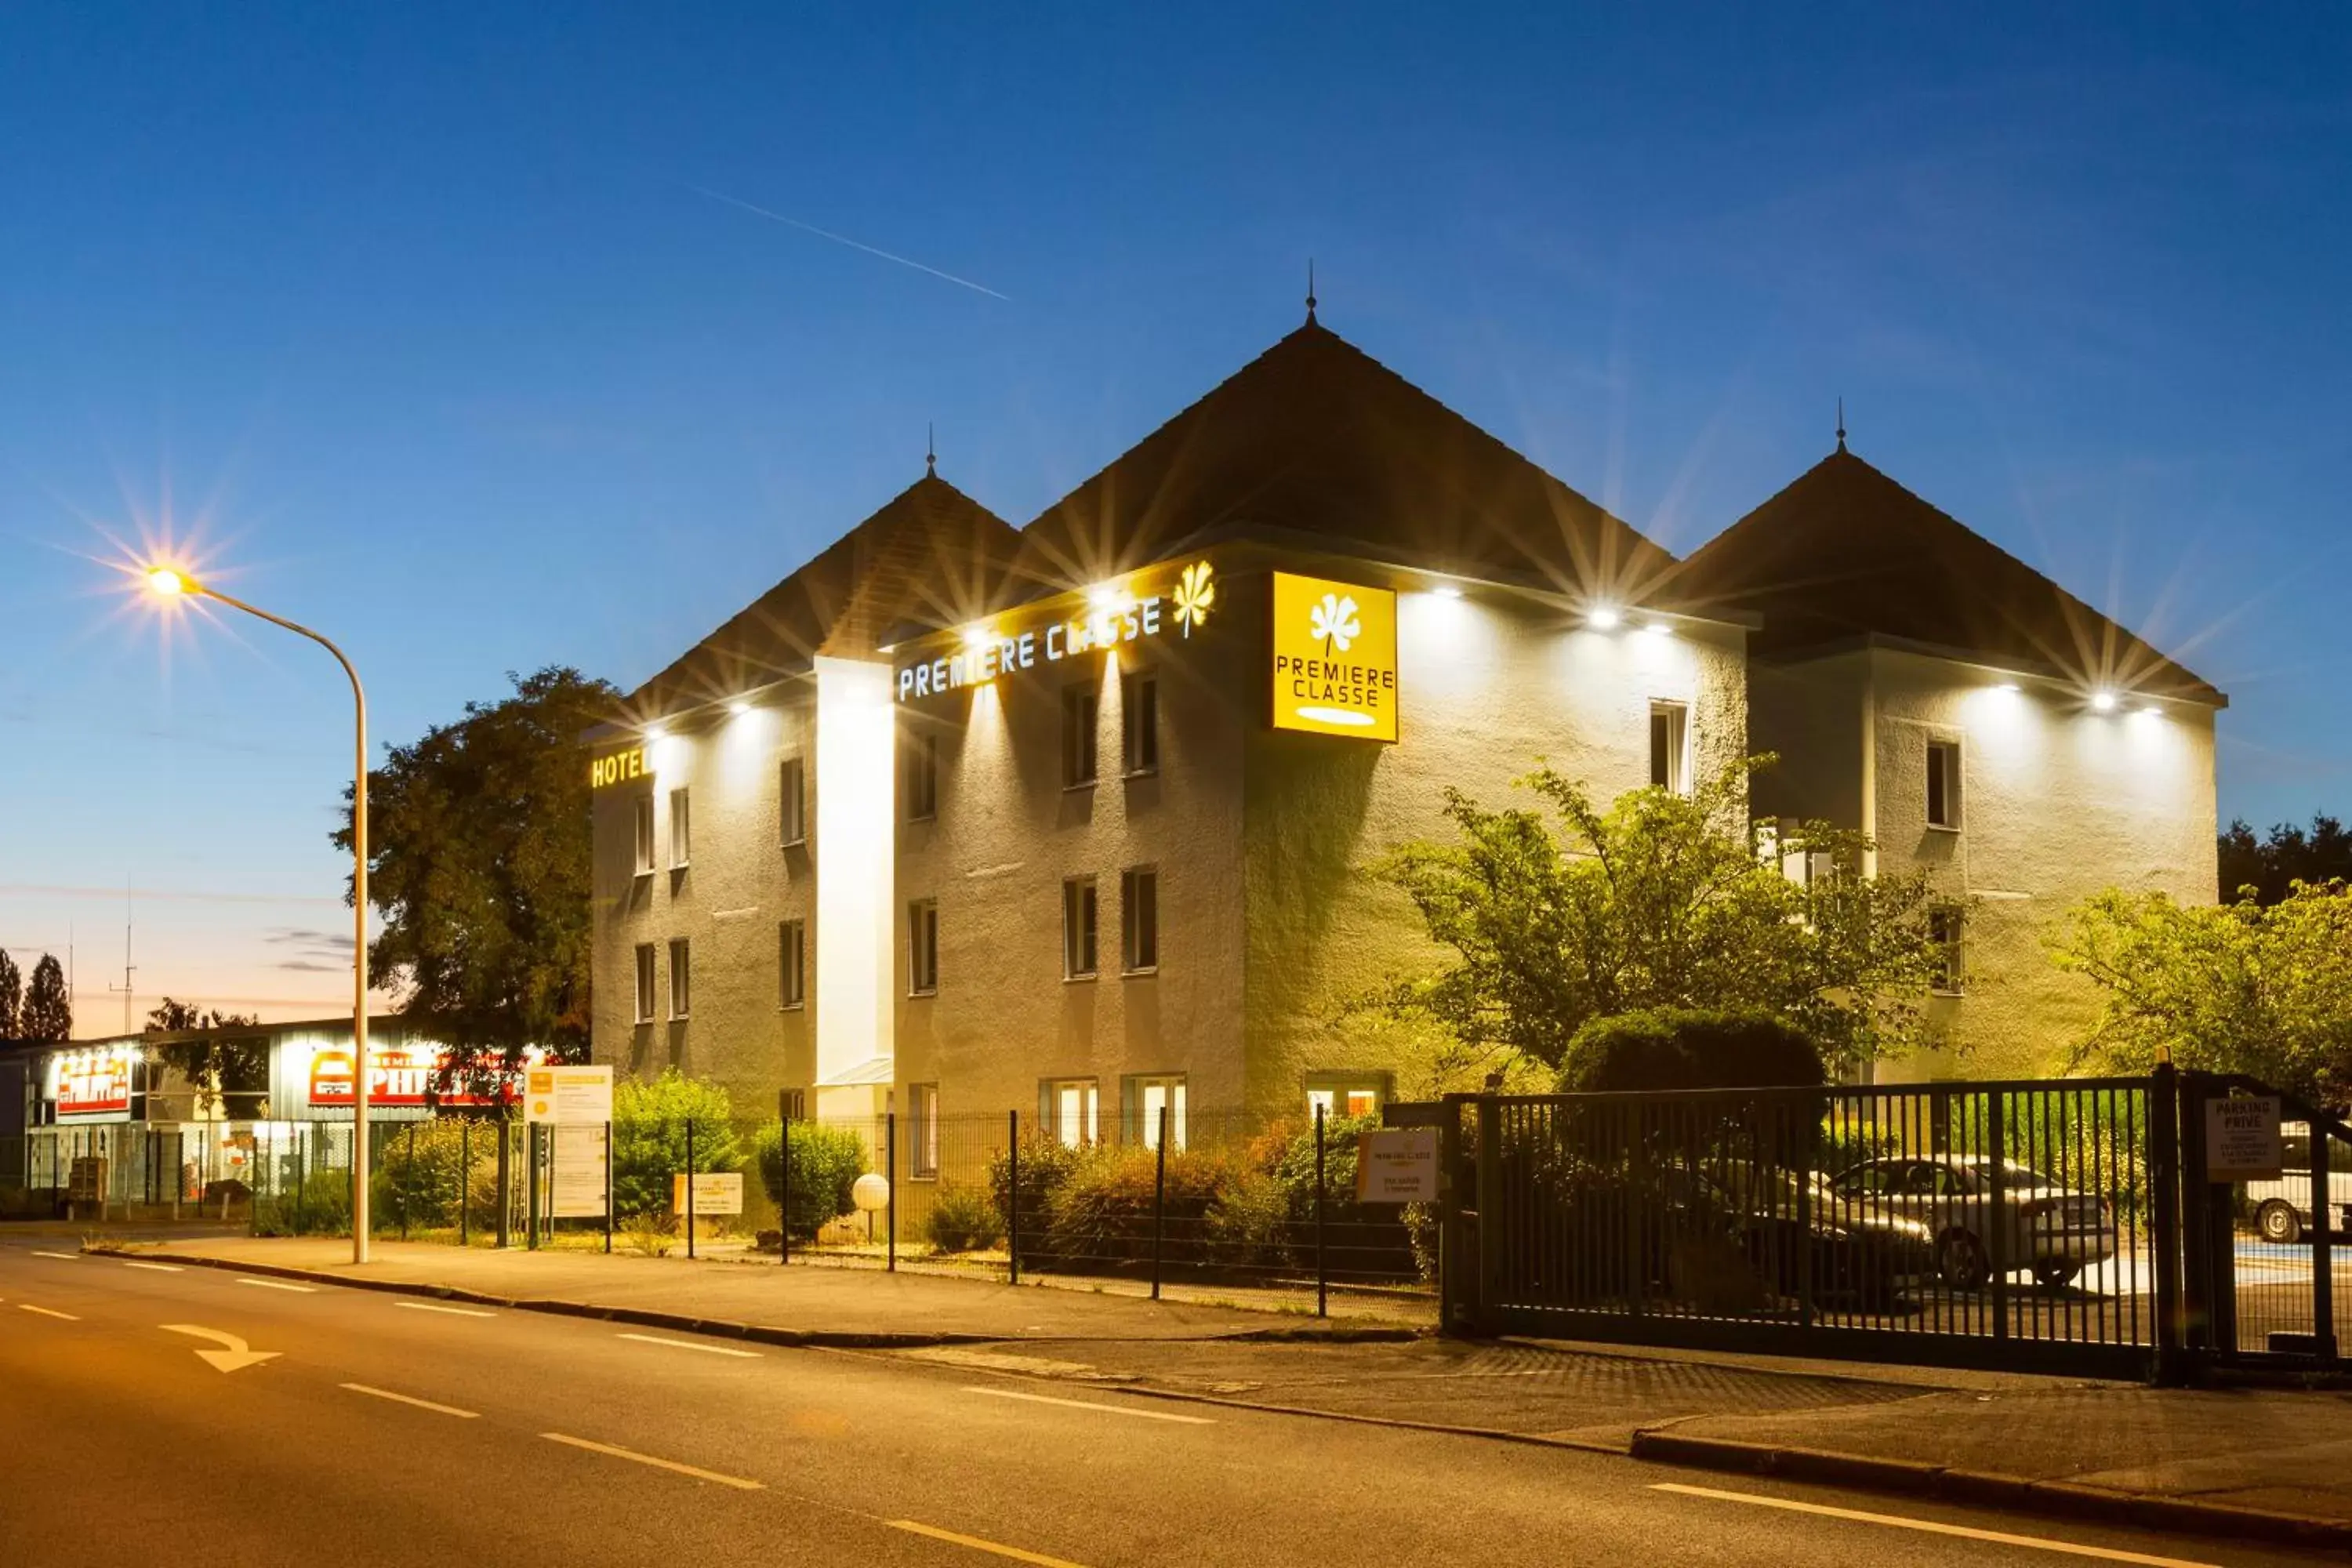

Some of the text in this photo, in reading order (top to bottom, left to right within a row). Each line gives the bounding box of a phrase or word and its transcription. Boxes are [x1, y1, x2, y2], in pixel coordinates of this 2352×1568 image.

[1276, 655, 1393, 688] PREMIERE
[1294, 679, 1377, 707] CLASSE
[592, 747, 655, 789] HOTEL
[2216, 1101, 2271, 1115] PARKING
